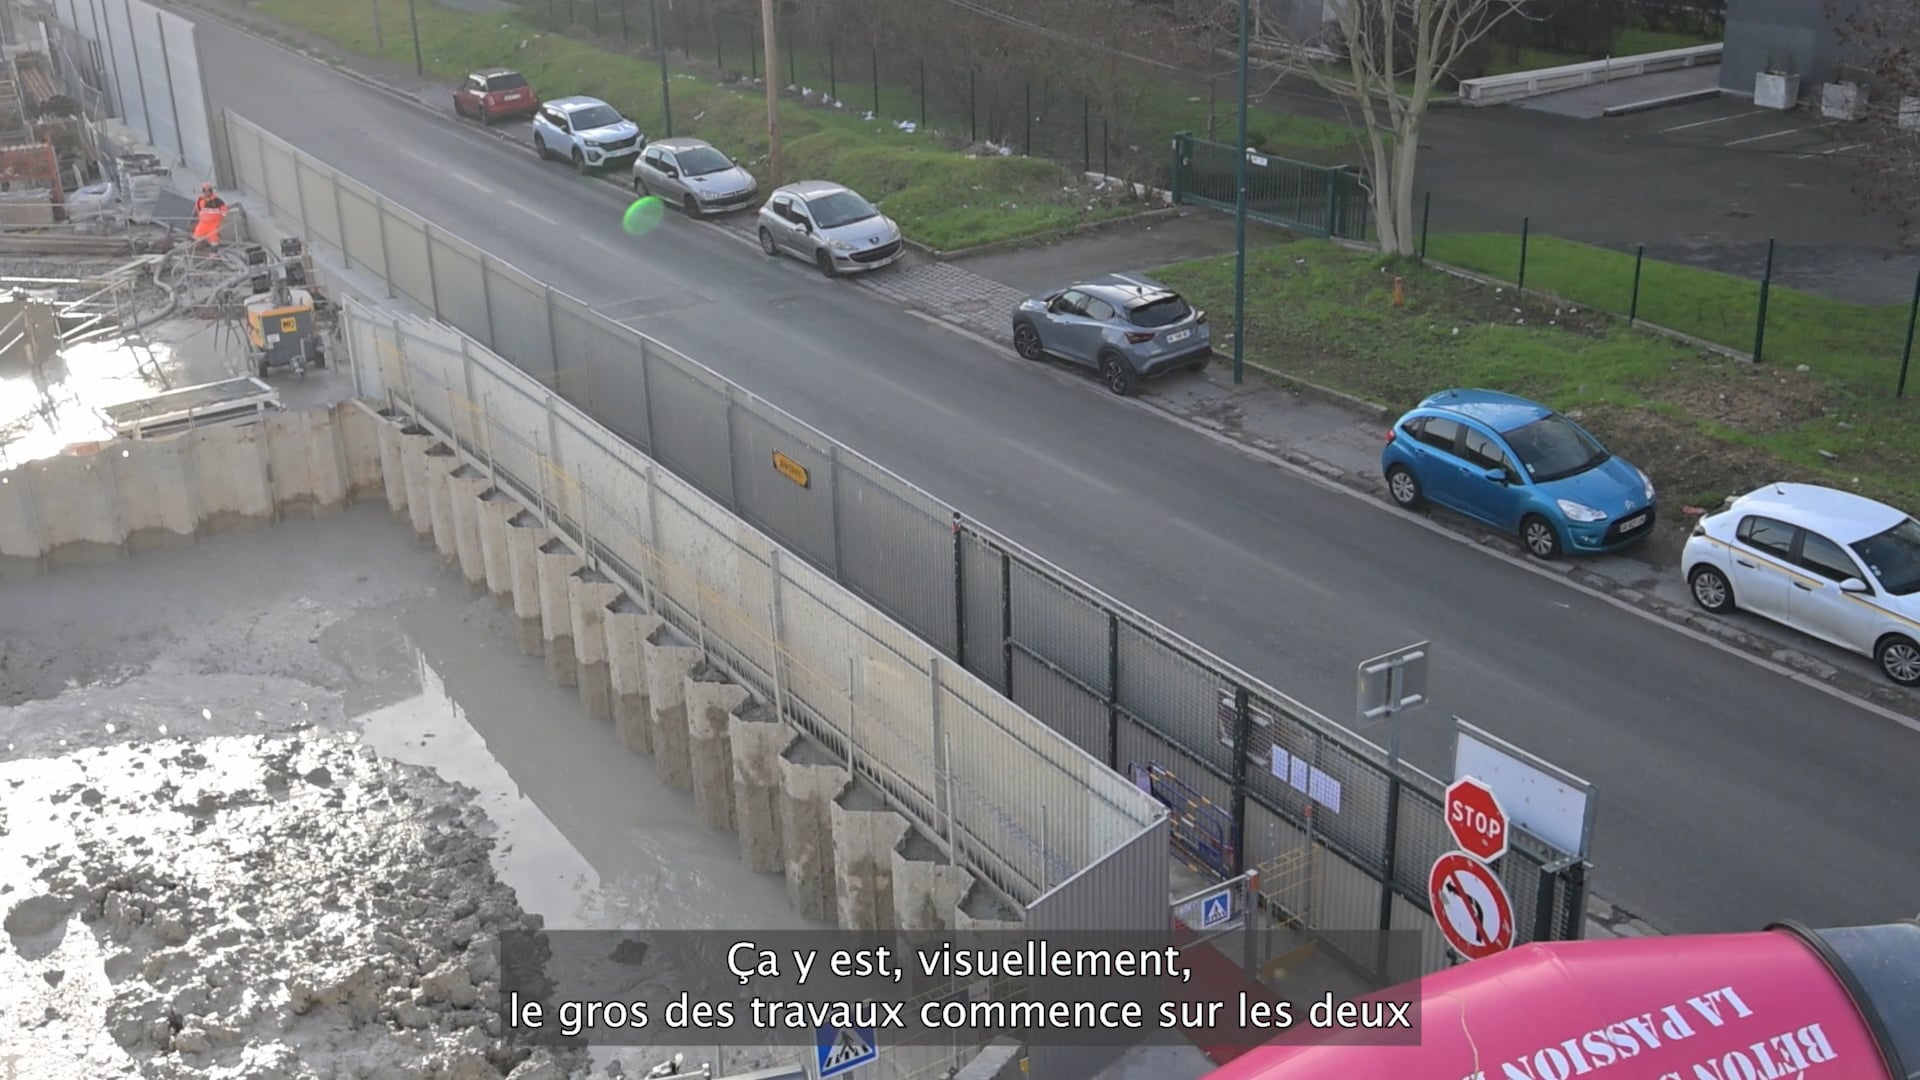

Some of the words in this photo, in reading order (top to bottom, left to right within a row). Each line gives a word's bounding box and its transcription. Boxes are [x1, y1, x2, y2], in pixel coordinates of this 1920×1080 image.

[1452, 800, 1501, 839] STOP
[1686, 986, 1754, 1027] LA
[1501, 1005, 1696, 1080] PASSION
